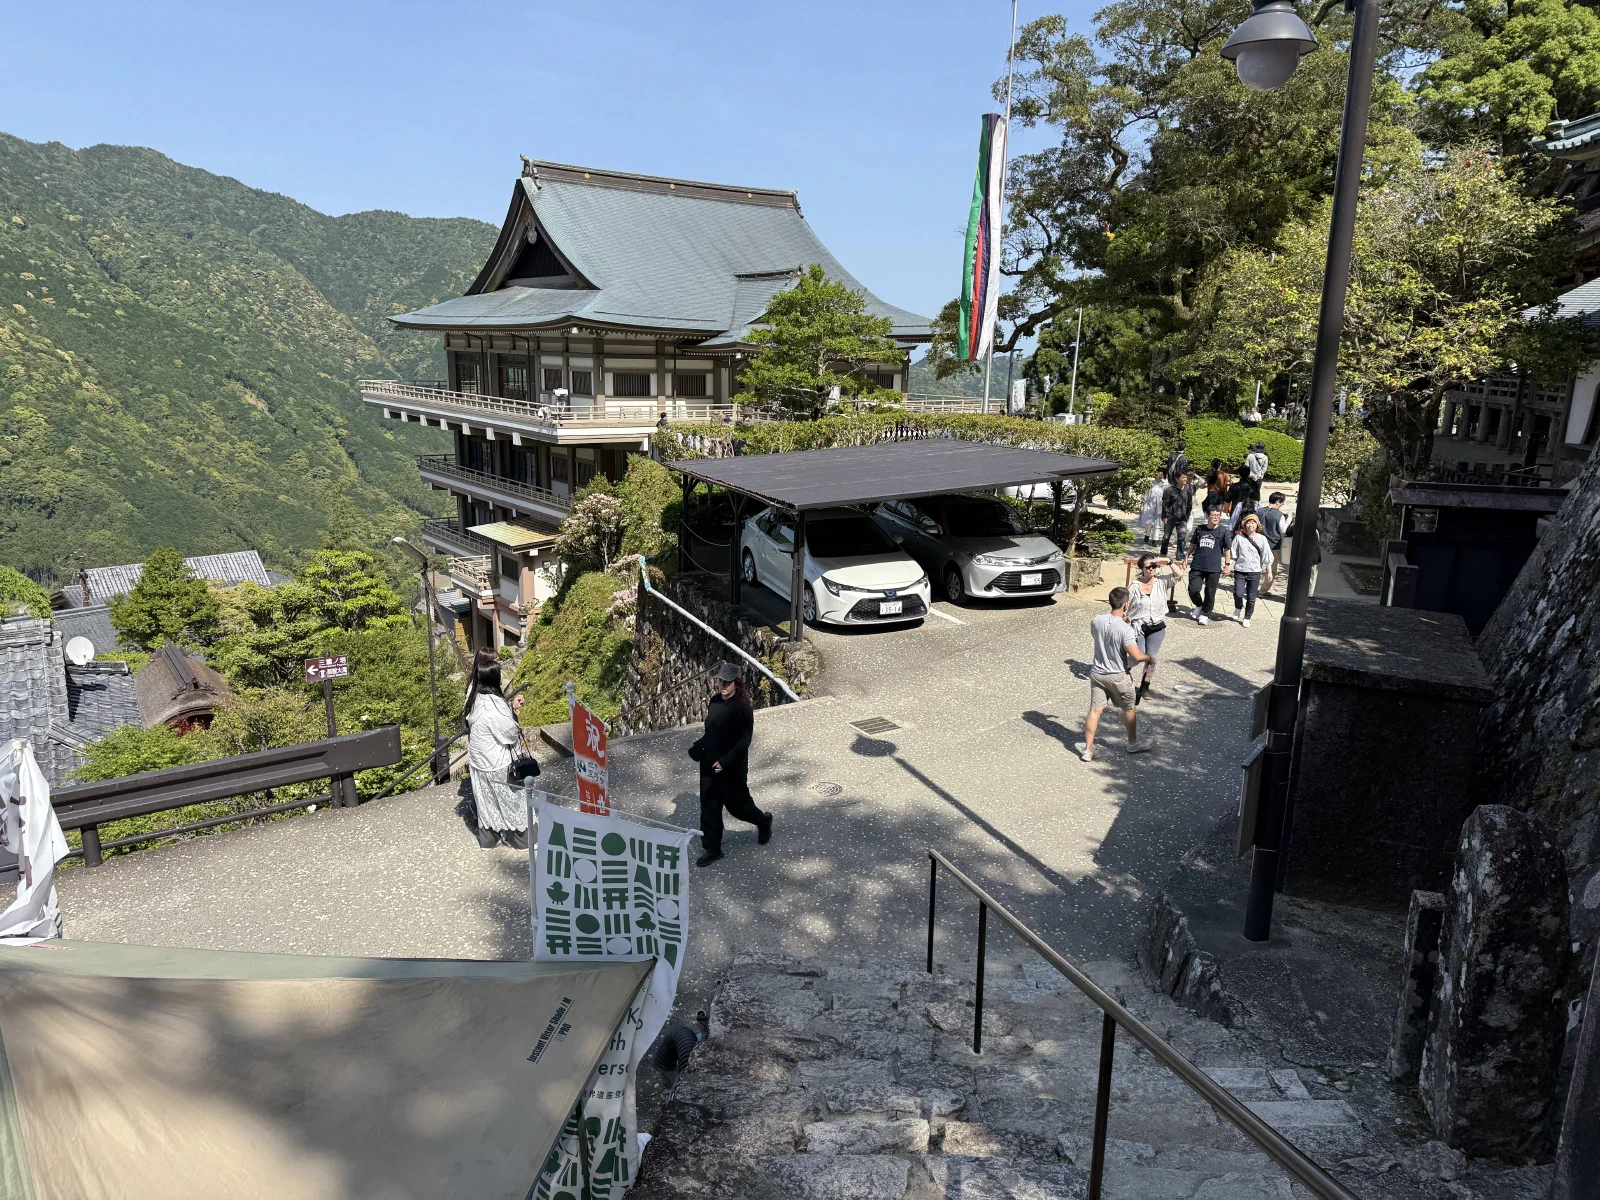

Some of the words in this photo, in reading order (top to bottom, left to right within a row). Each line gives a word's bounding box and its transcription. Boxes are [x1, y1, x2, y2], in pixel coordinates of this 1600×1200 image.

[585, 718, 605, 758] 祝
[526, 1039, 547, 1063] Instant
[539, 1024, 555, 1041] Visor
[548, 1006, 566, 1025] Shade
[562, 996, 573, 1005] M
